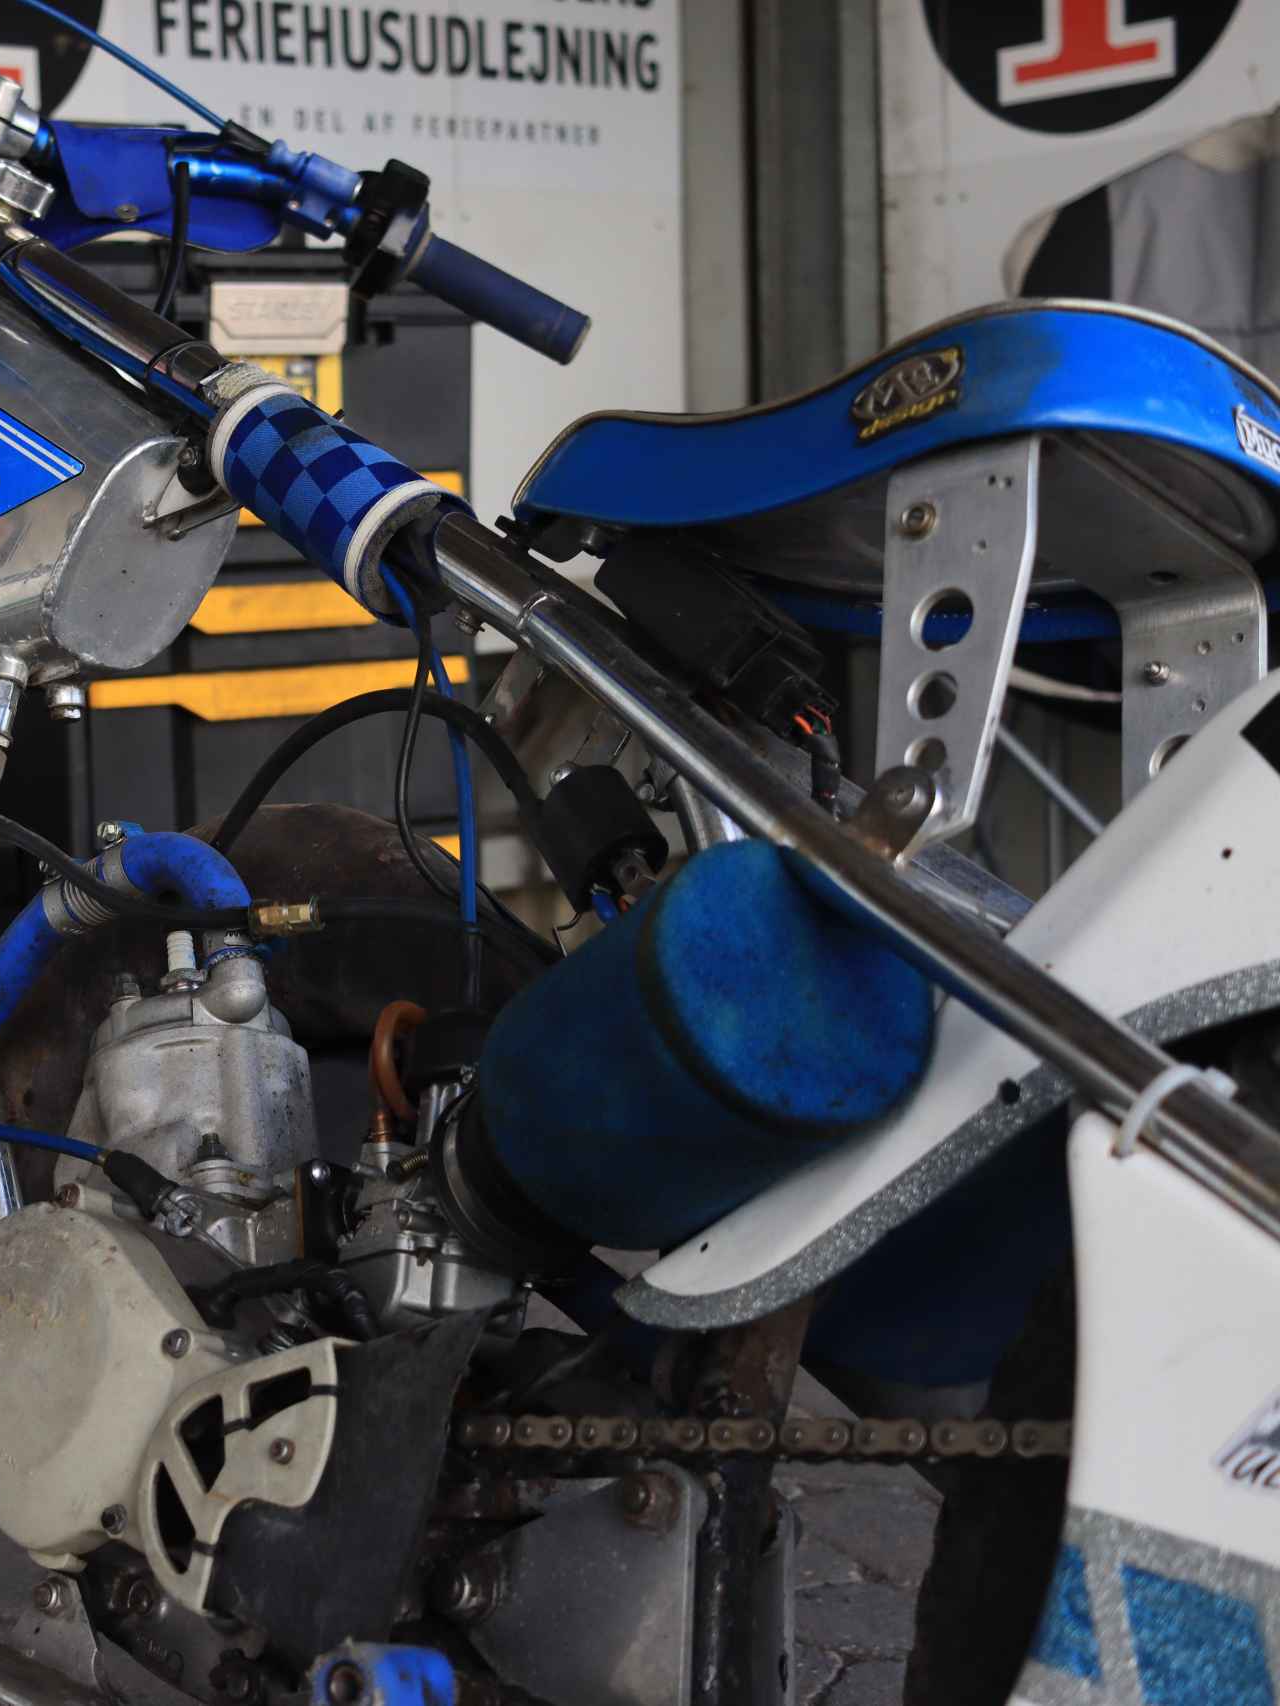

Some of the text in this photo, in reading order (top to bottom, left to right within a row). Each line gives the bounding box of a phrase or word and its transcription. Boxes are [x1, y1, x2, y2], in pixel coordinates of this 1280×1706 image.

[153, 0, 660, 91] FERIEHUSUDLEJNING
[239, 104, 602, 146] EN DEL AF FERIEPARTNER
